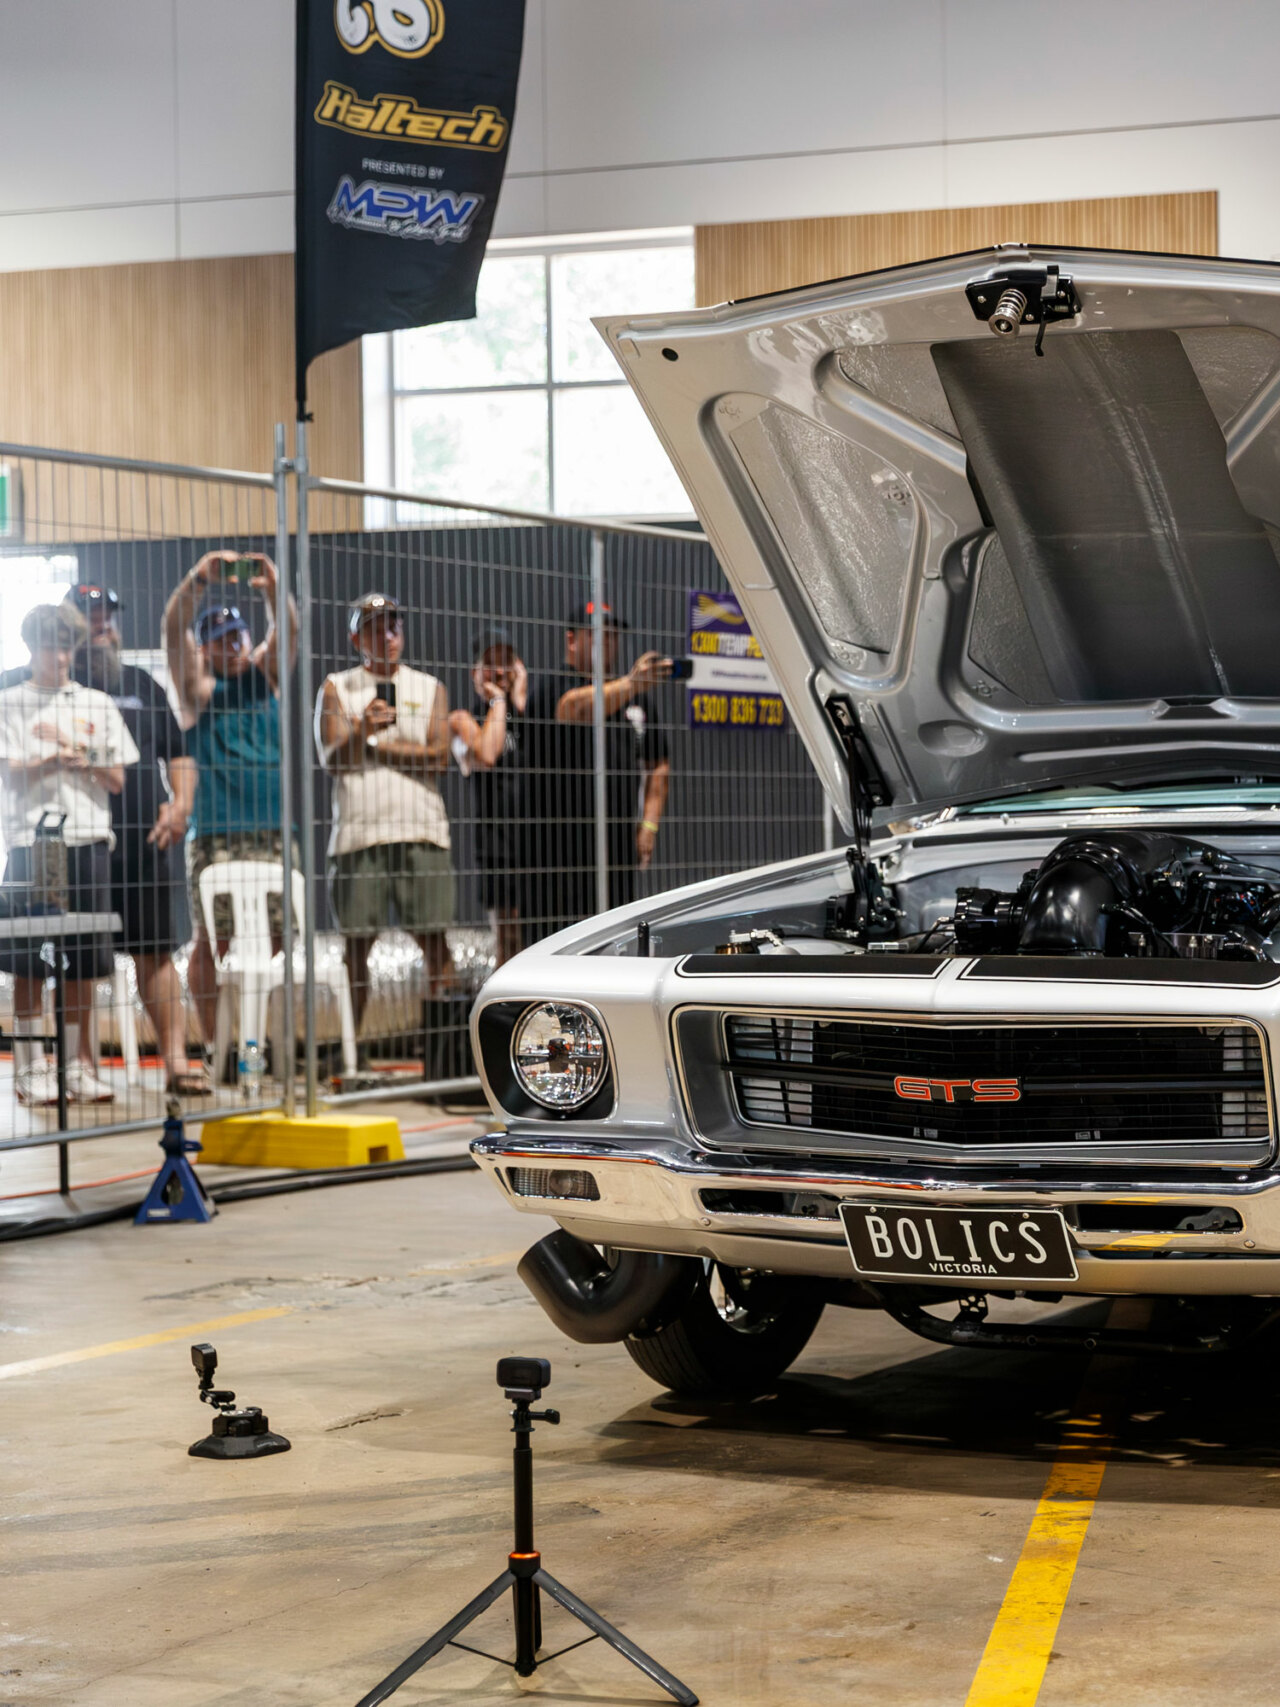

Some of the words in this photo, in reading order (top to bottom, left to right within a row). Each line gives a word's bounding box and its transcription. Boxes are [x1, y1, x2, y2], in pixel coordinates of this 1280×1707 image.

[318, 84, 508, 149] Haltech
[362, 157, 427, 178] PRESENTED
[428, 165, 445, 180] BY
[334, 177, 481, 228] MPW
[692, 693, 729, 723] 1300
[894, 1075, 1021, 1103] GTS
[865, 1215, 1048, 1264] BOLICS
[928, 1262, 998, 1275] VICTORIA
